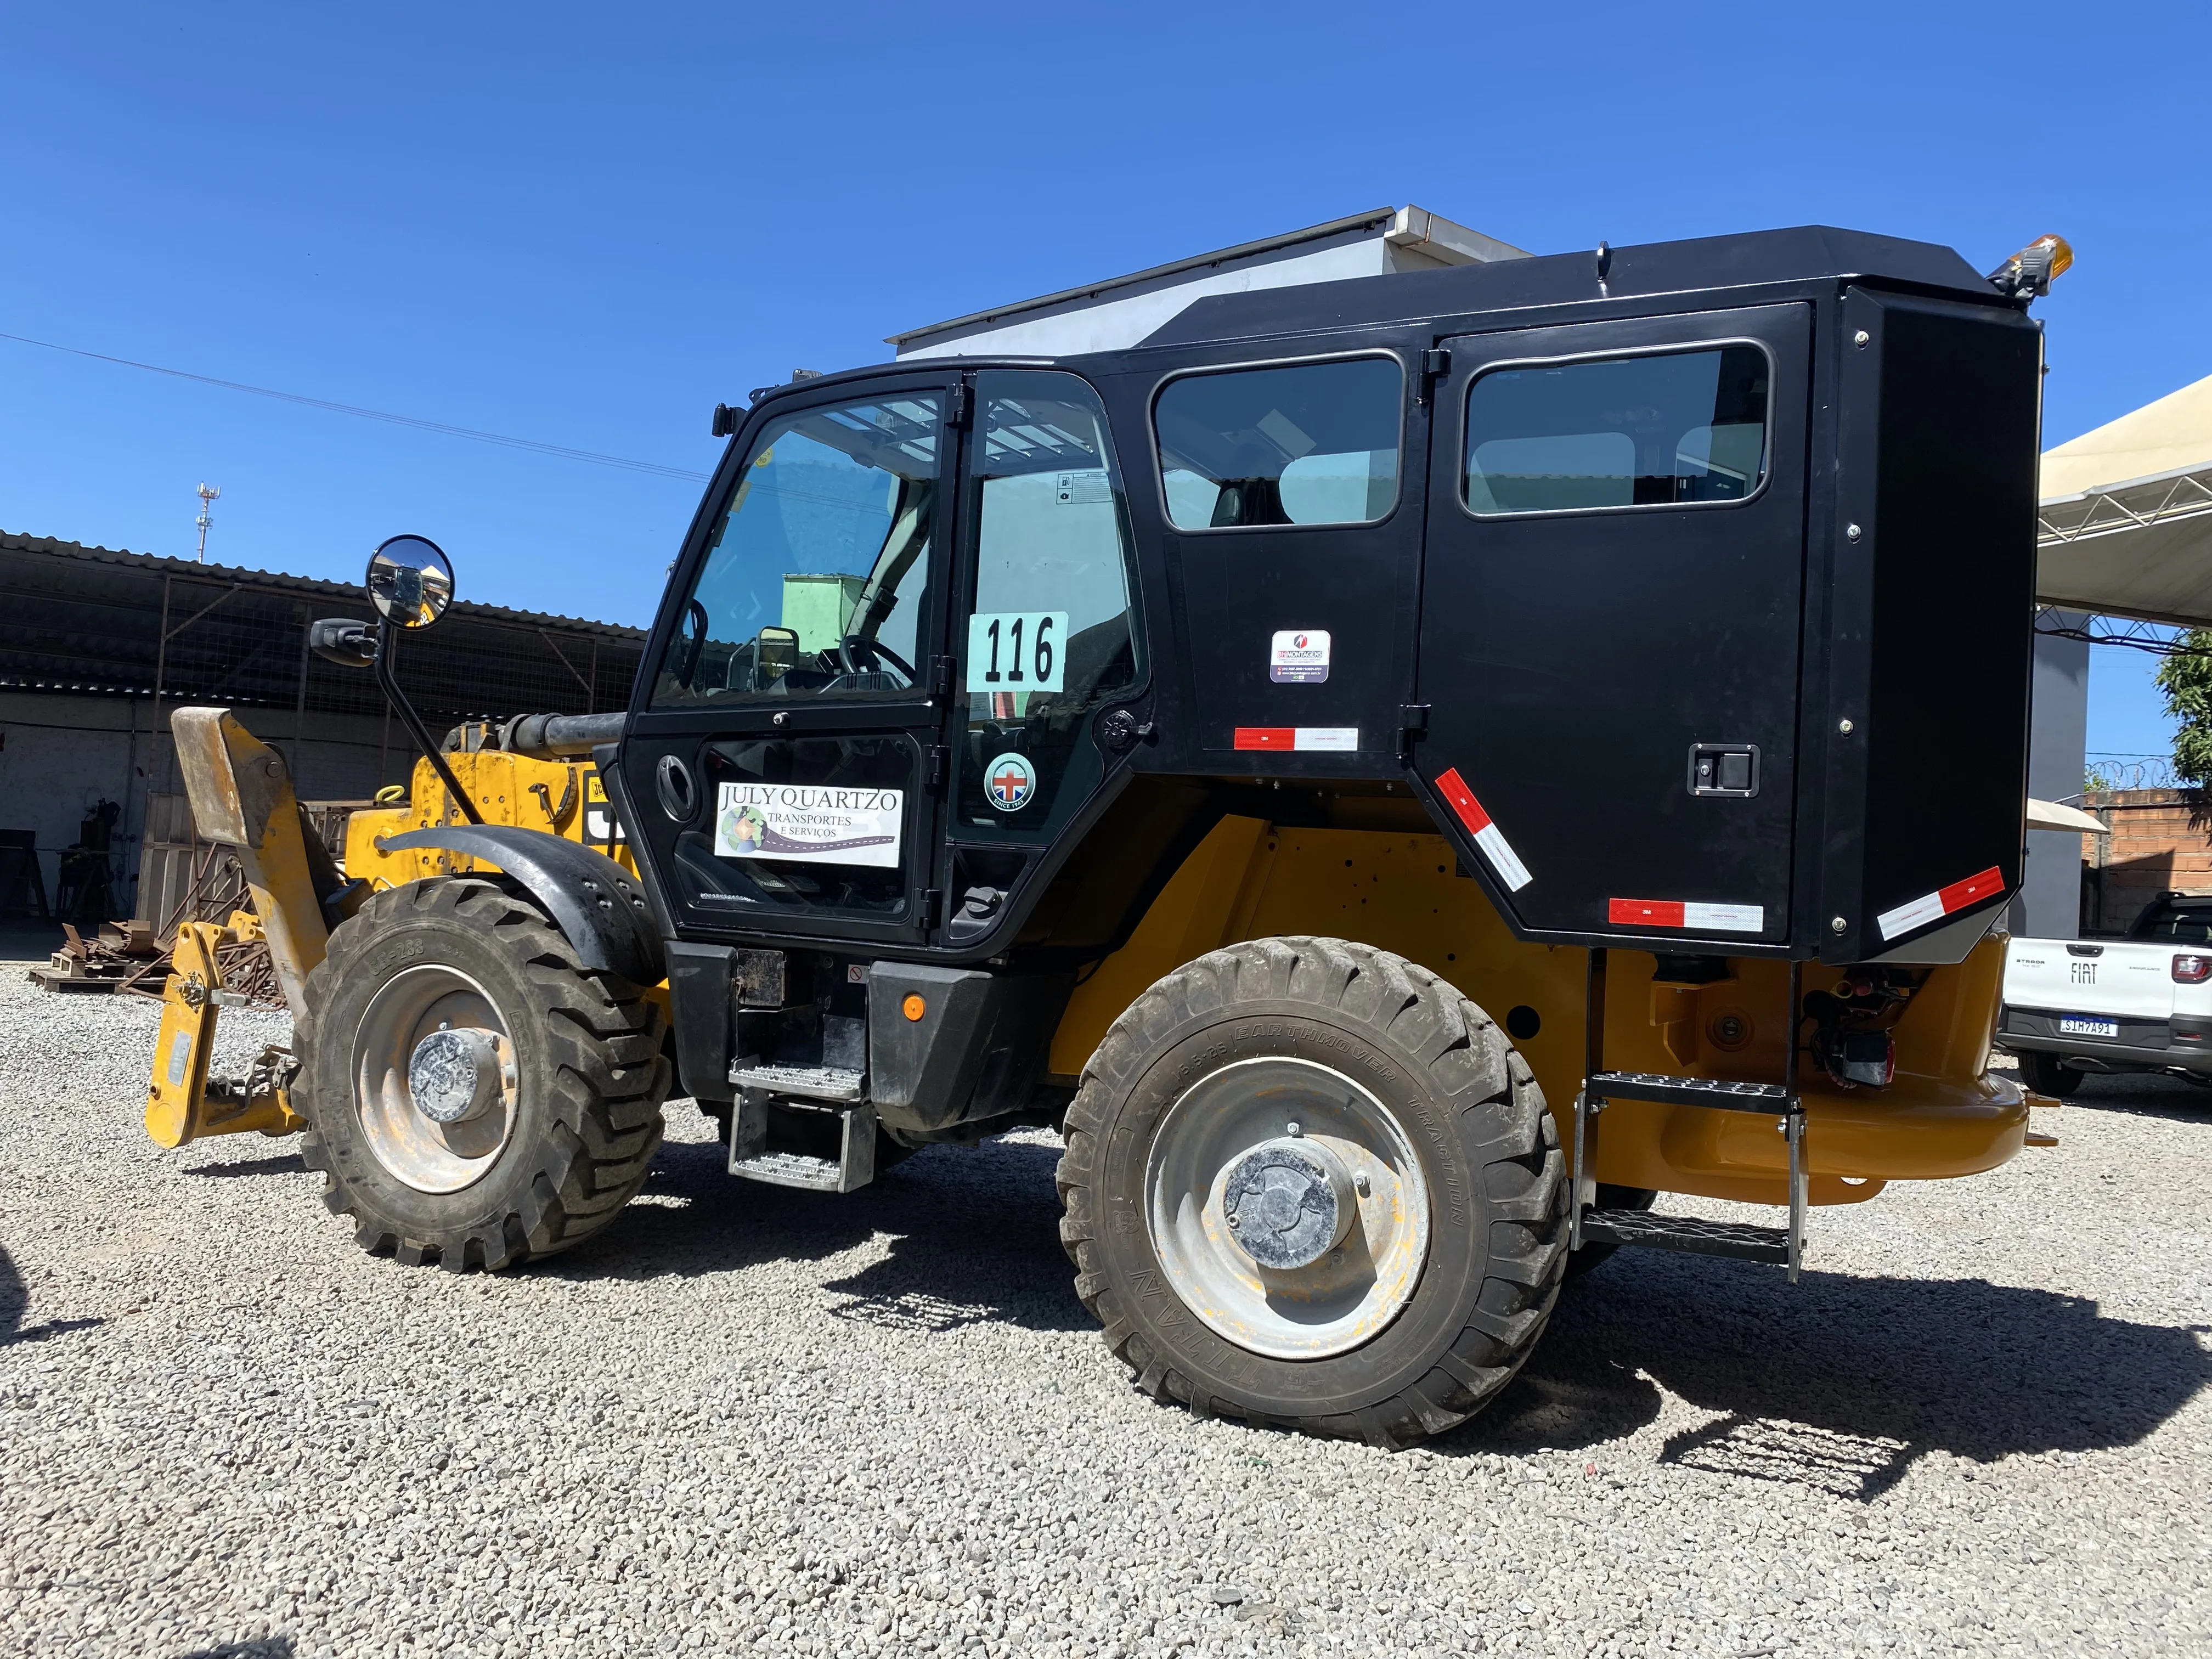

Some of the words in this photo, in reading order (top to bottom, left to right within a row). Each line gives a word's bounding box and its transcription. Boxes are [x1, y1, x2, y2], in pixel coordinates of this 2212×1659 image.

[985, 616, 1053, 683] 116
[594, 783, 603, 795] JC
[720, 786, 777, 811] JULY
[781, 788, 898, 811] QUARTZO
[994, 798, 1010, 809] SINCE
[1012, 799, 1024, 808] 1945
[768, 812, 852, 827] TRANSPORTES
[781, 826, 787, 834] E
[789, 827, 837, 838] SERVIÇOS
[2072, 962, 2098, 985] FIAT
[1234, 1022, 1398, 1084] EARTHMOVER
[1408, 1094, 1466, 1227] TRACTION
[1125, 1264, 1268, 1392] TITAN
